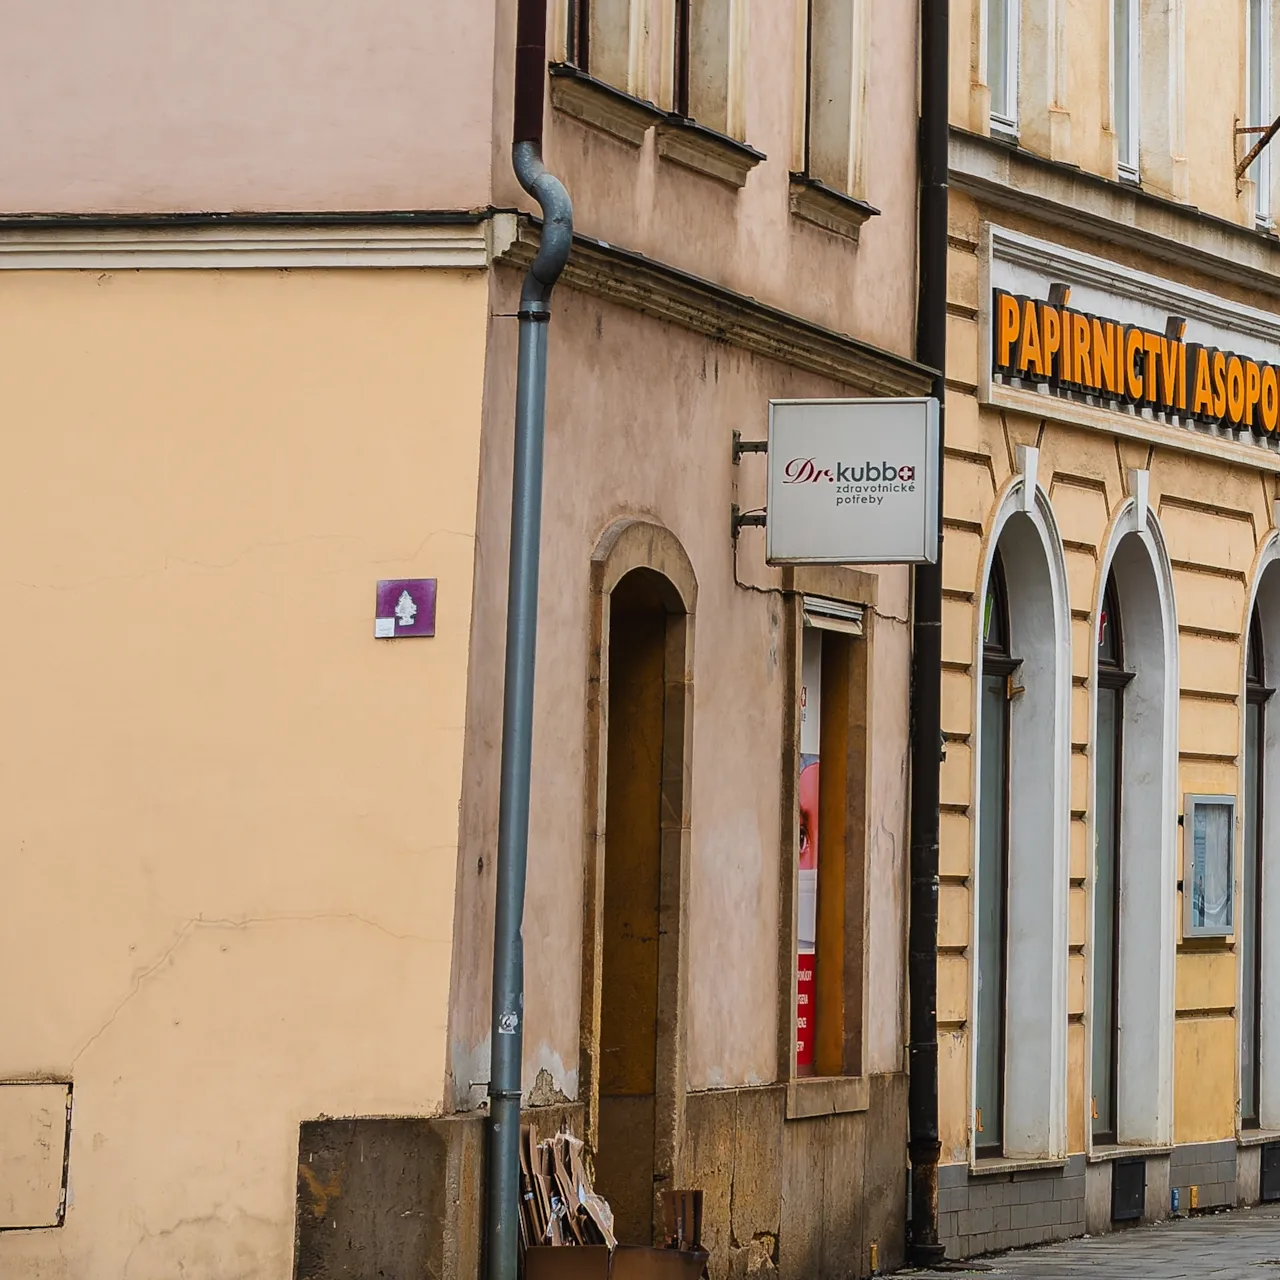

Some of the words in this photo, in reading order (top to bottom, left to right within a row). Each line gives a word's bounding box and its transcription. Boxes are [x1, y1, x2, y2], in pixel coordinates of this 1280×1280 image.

[996, 287, 1188, 410] PAPÍRNICTVÍ
[836, 482, 915, 493] zdravotnické
[836, 494, 883, 506] potřeby
